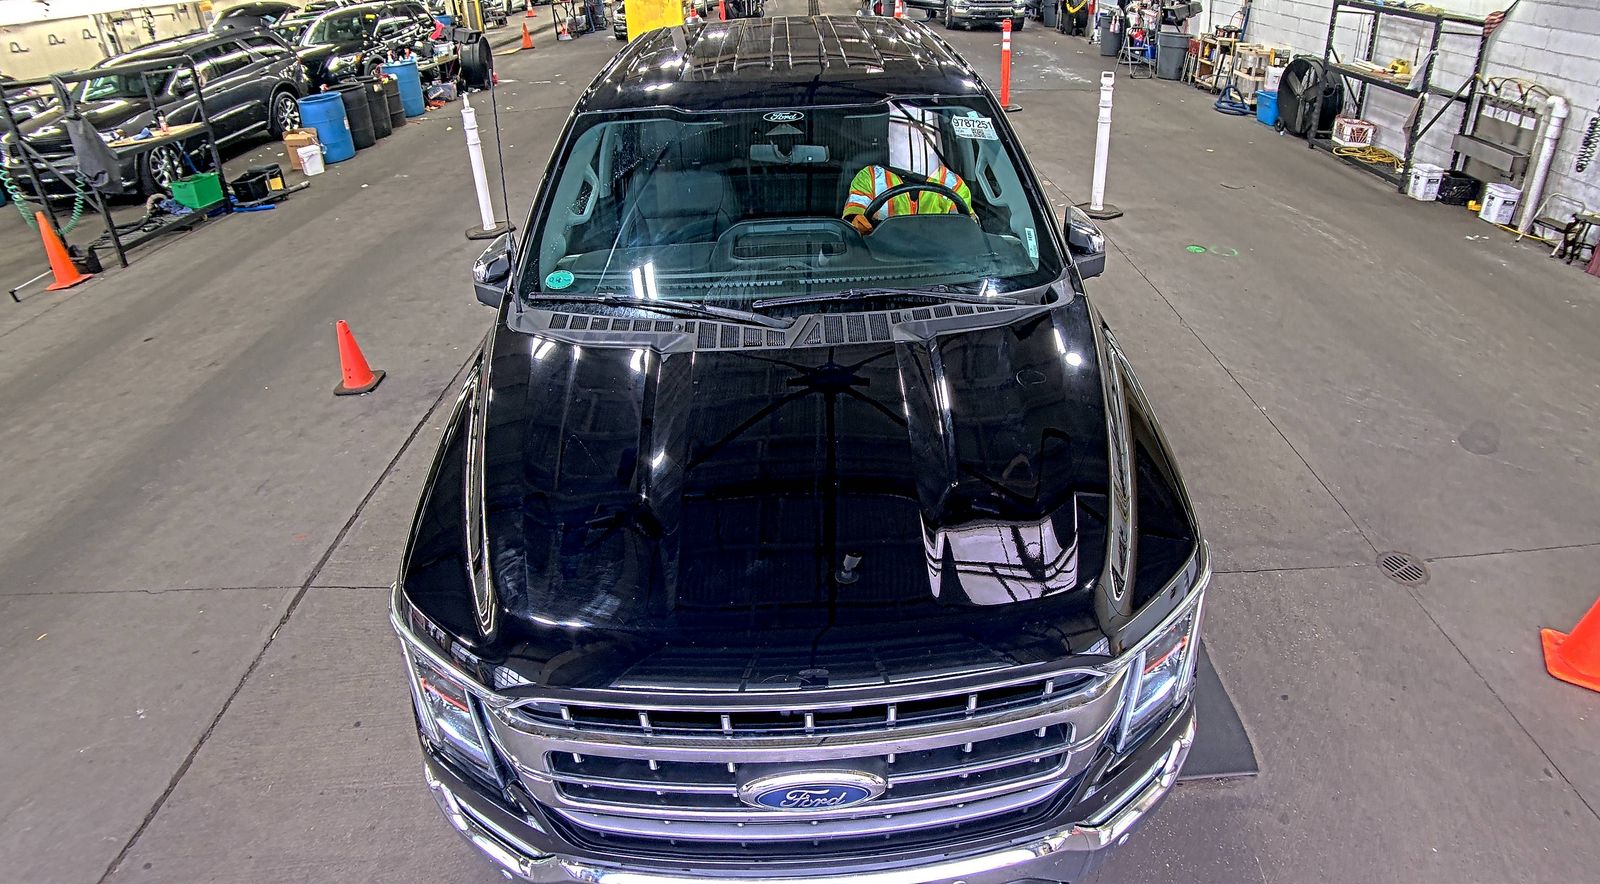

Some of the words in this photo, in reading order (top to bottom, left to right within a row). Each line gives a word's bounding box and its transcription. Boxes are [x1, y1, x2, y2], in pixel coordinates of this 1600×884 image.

[770, 112, 797, 121] Ford
[952, 118, 993, 129] 9787251
[780, 789, 847, 807] Ford
